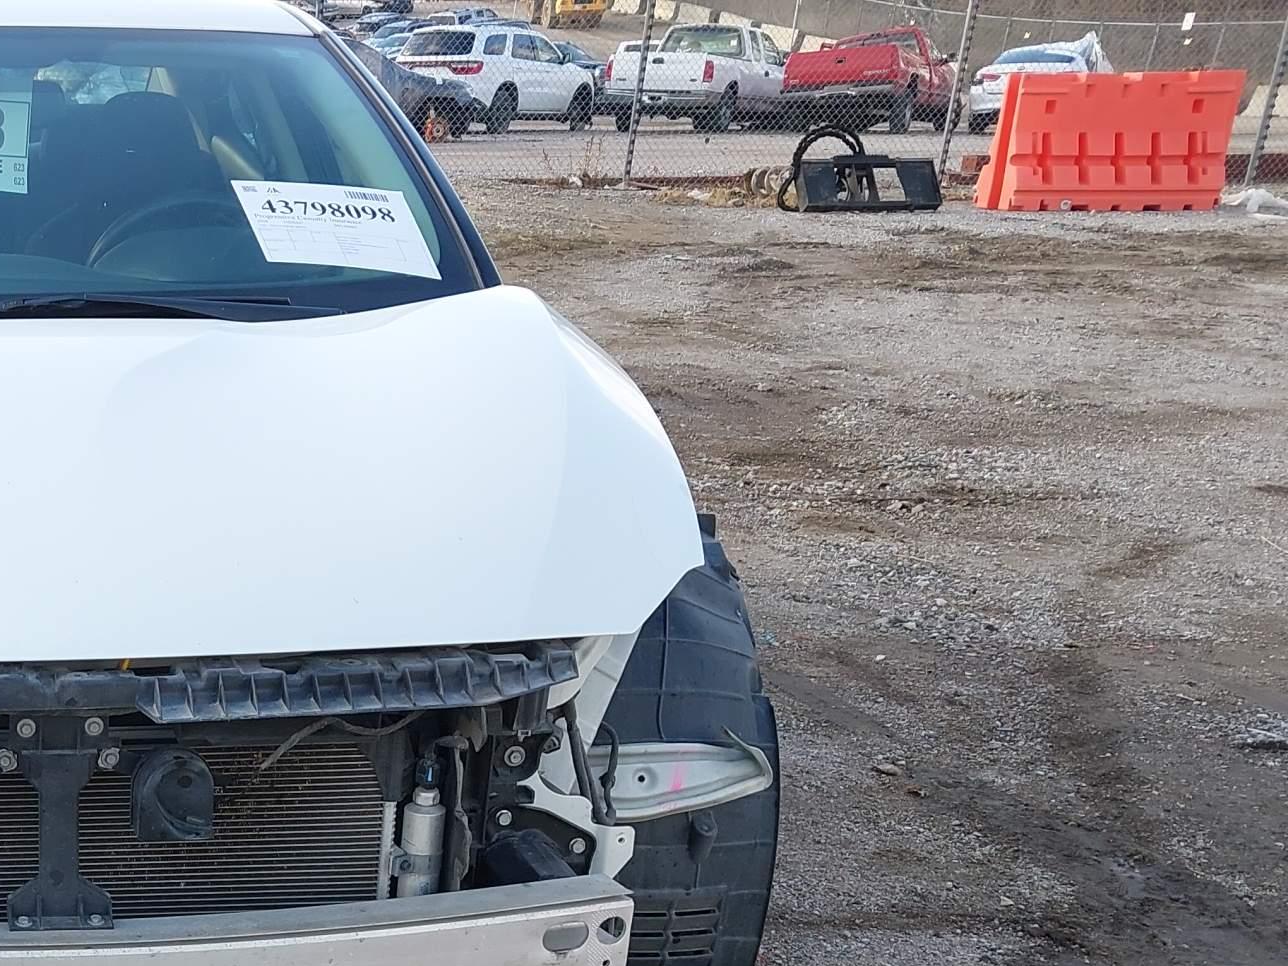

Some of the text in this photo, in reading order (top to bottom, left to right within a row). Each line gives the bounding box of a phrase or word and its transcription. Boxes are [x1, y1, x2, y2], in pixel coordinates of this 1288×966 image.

[13, 163, 25, 172] 623
[13, 177, 25, 186] 623
[262, 199, 395, 223] 43798098
